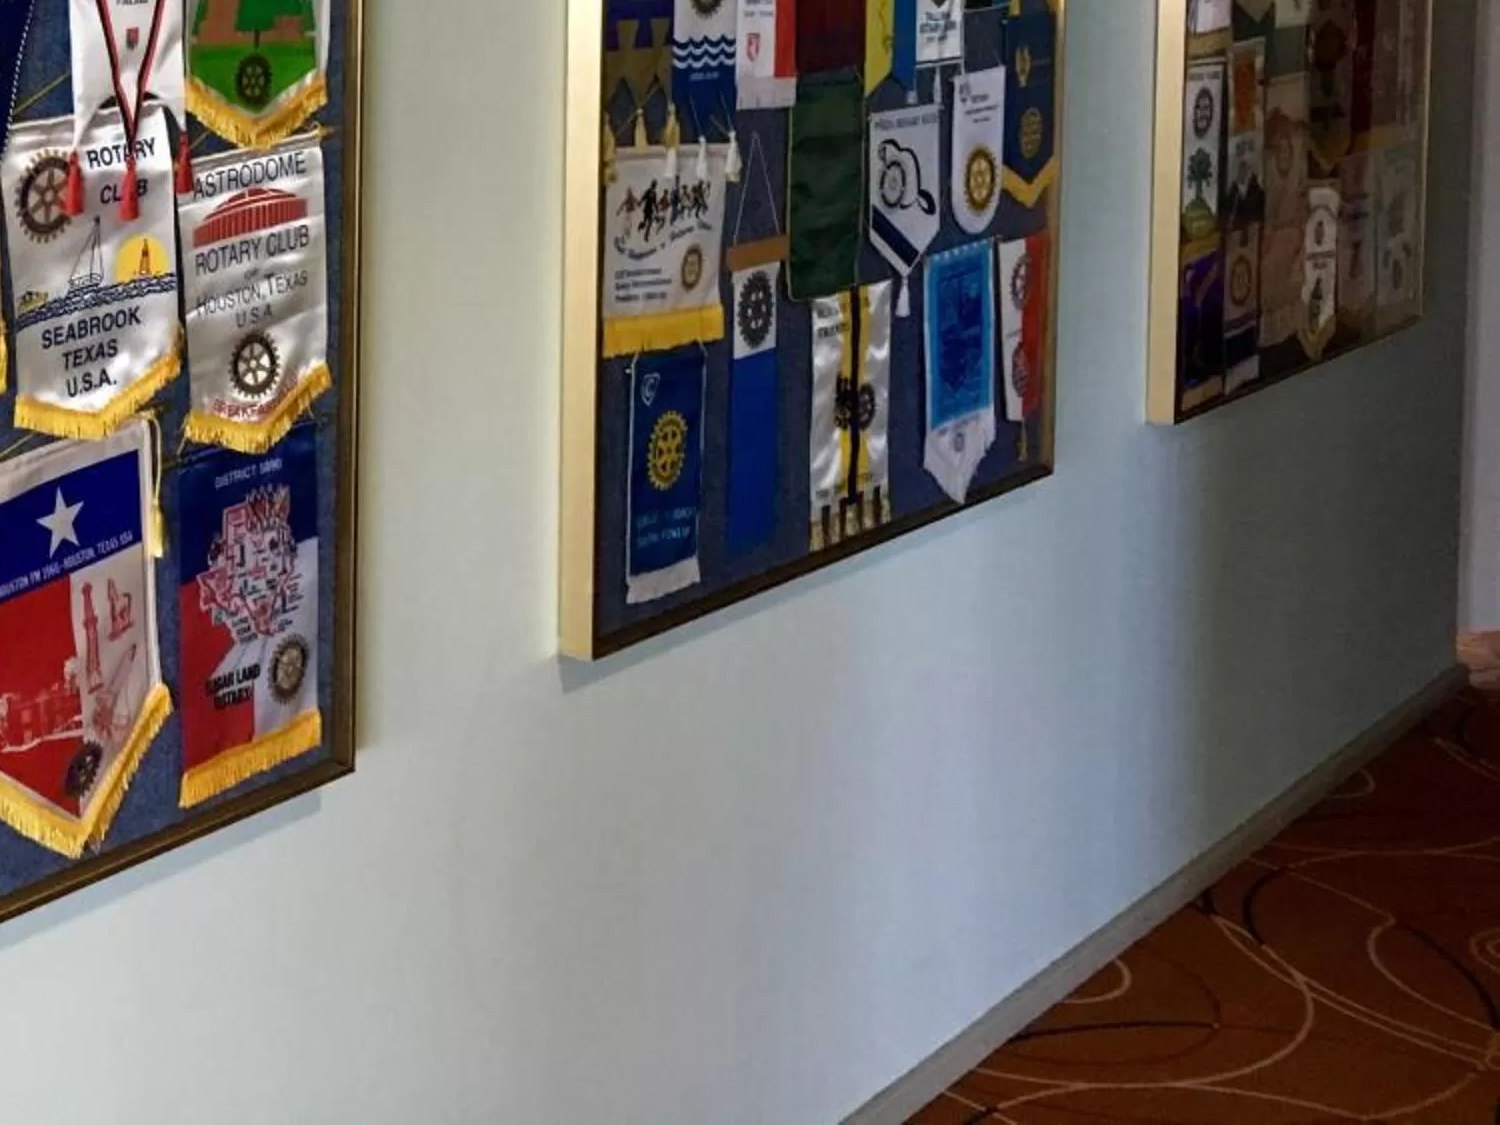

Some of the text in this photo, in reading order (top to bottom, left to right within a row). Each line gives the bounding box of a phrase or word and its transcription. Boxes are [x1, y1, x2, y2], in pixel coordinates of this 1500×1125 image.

[87, 137, 156, 169] ROTARY
[100, 179, 149, 205] CLB
[193, 152, 307, 200] ASTRODOME
[195, 225, 310, 276] ROTARY CLUB
[42, 306, 142, 350] SEABROOK
[62, 339, 118, 370] TEXAS
[67, 375, 118, 398] U.S.A.
